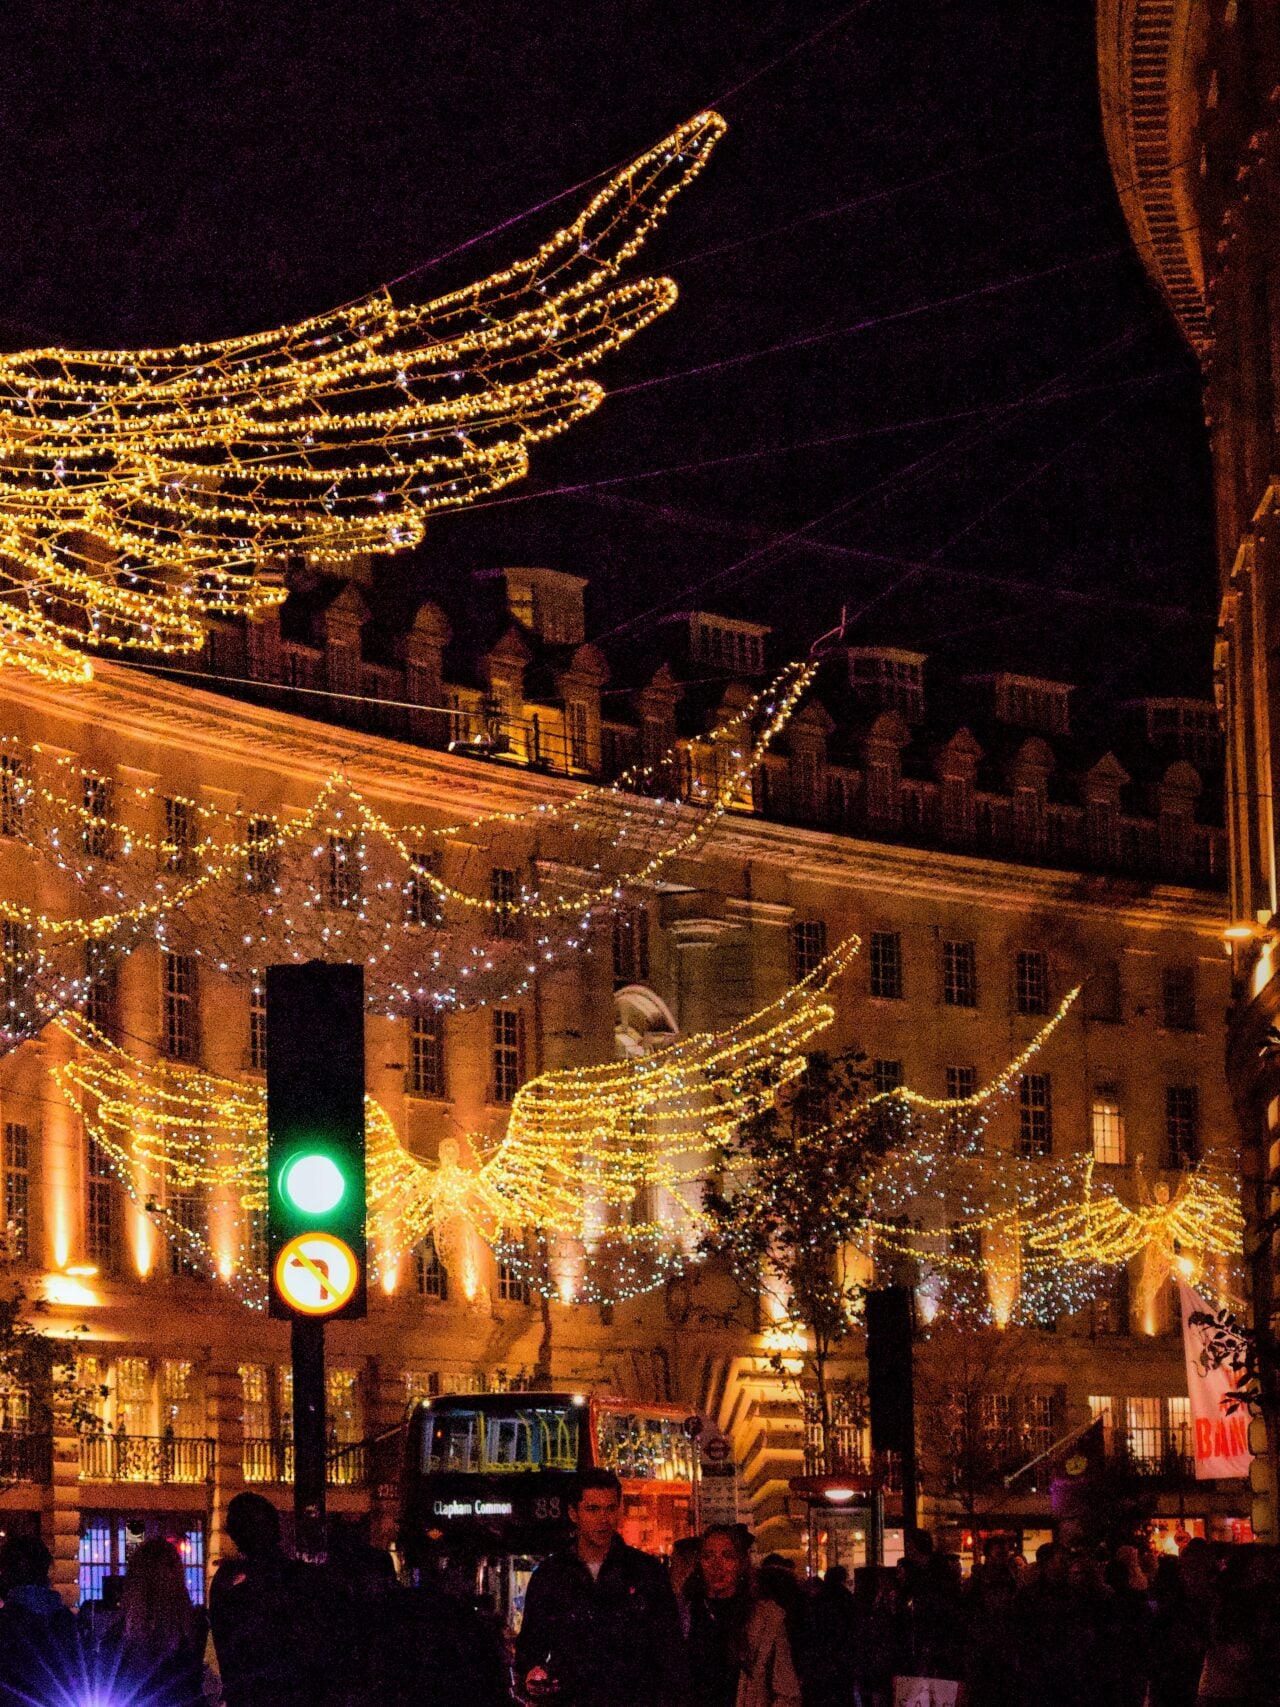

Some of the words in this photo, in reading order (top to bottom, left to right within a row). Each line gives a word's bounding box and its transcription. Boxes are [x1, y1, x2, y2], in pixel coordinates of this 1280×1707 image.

[434, 1500, 472, 1519] Clapham
[475, 1500, 512, 1515] Common
[535, 1497, 561, 1519] 88
